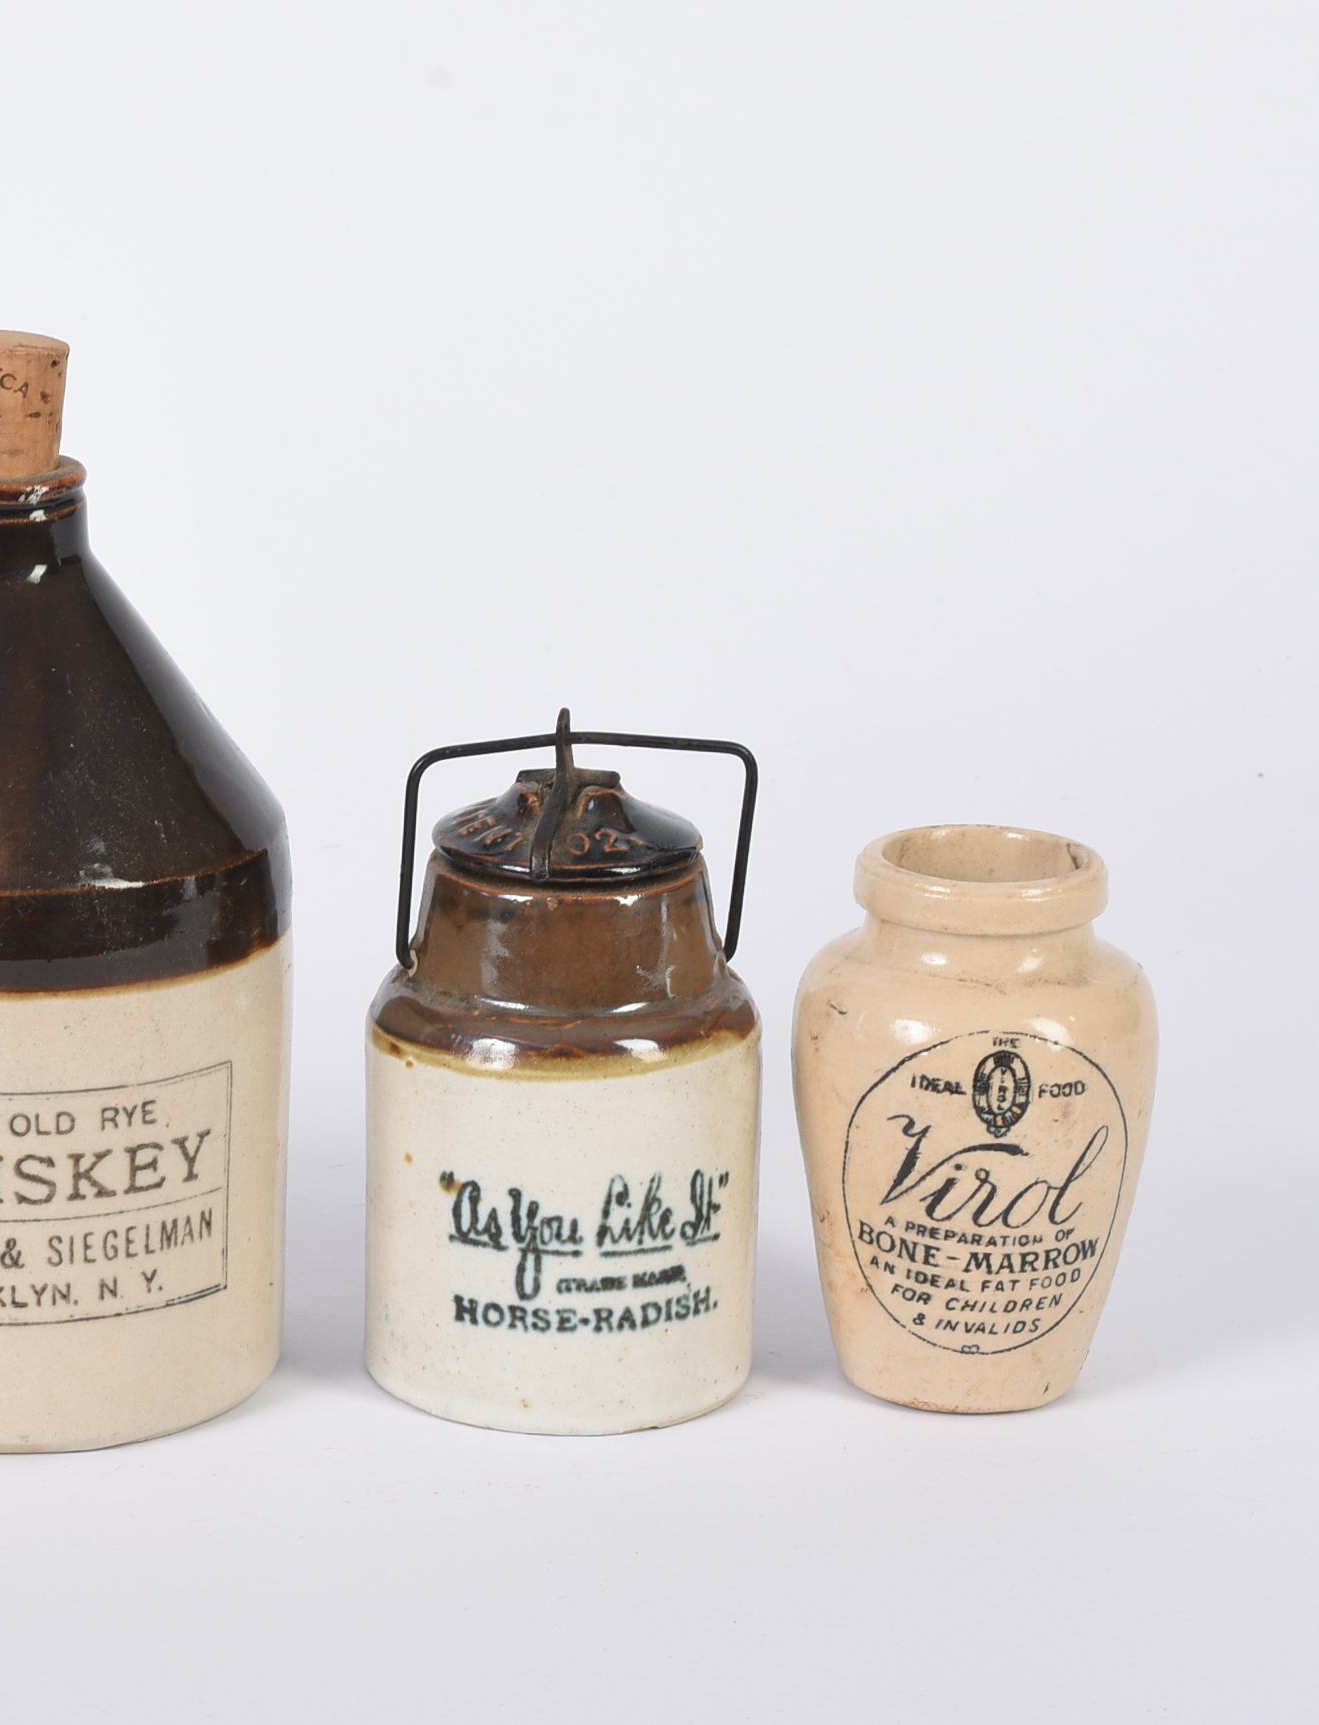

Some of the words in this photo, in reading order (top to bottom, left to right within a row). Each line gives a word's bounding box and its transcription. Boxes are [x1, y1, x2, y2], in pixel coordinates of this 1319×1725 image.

[992, 1037, 1021, 1049] THE
[910, 1073, 967, 1096] IDEAL
[1038, 1080, 1086, 1099] FOOD
[8, 1110, 76, 1137] OLD
[100, 1099, 158, 1131] RYE
[880, 1114, 1109, 1230] Virol
[0, 1237, 26, 1269] &
[47, 1207, 213, 1267] SIEGELMAN
[507, 1186, 584, 1301] You
[595, 1173, 676, 1248] Like
[884, 1215, 897, 1228] A
[904, 1220, 1043, 1248] PREPARATION
[1054, 1226, 1076, 1243] OF
[869, 1255, 896, 1276] AN
[905, 1268, 971, 1293] IDEAL
[980, 1278, 1021, 1294] FAT
[1028, 1267, 1082, 1291] FOOD
[890, 1282, 933, 1306] FOR
[944, 1292, 1064, 1314] CHILDREN
[912, 1312, 928, 1326] &
[934, 1317, 1042, 1336] INVALIDS
